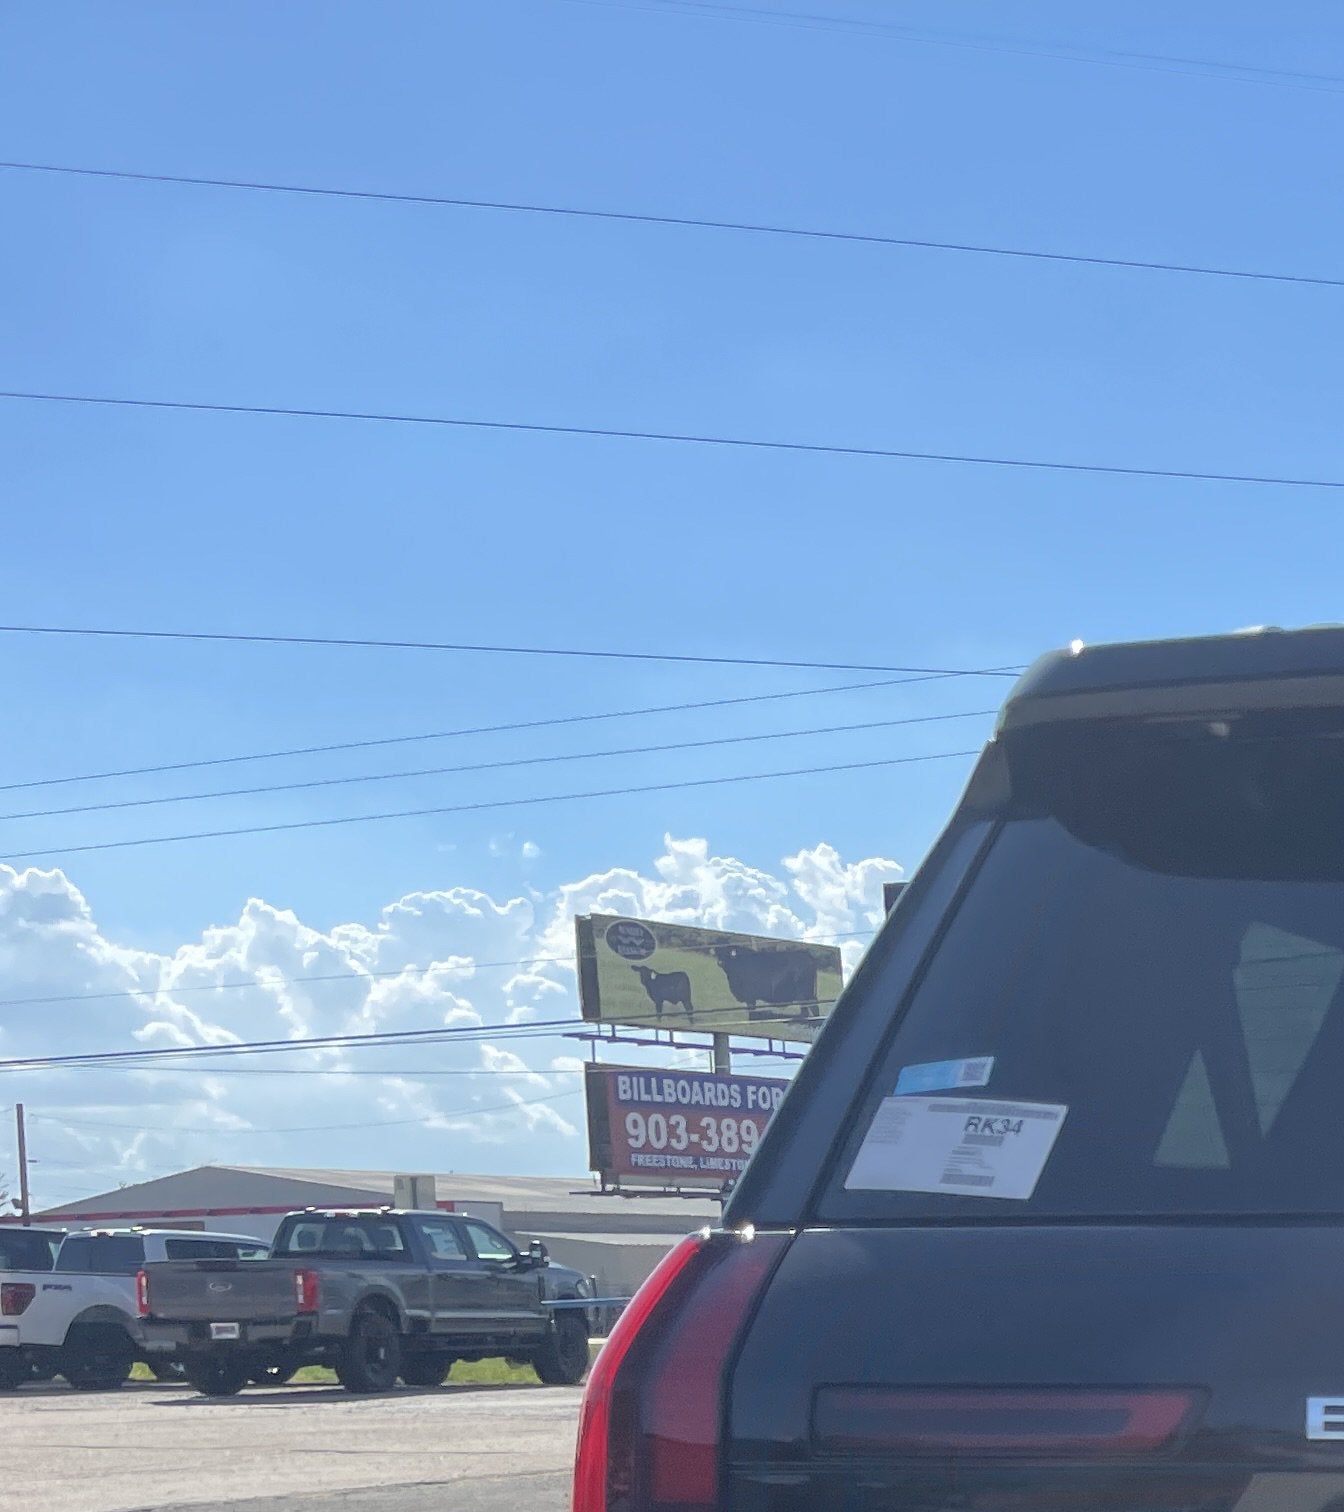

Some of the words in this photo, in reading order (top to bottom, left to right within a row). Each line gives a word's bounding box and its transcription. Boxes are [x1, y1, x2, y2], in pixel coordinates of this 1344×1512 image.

[617, 1075, 742, 1108] BILLBOARDS
[747, 1085, 784, 1111] FOR
[964, 1116, 1024, 1135] RK34
